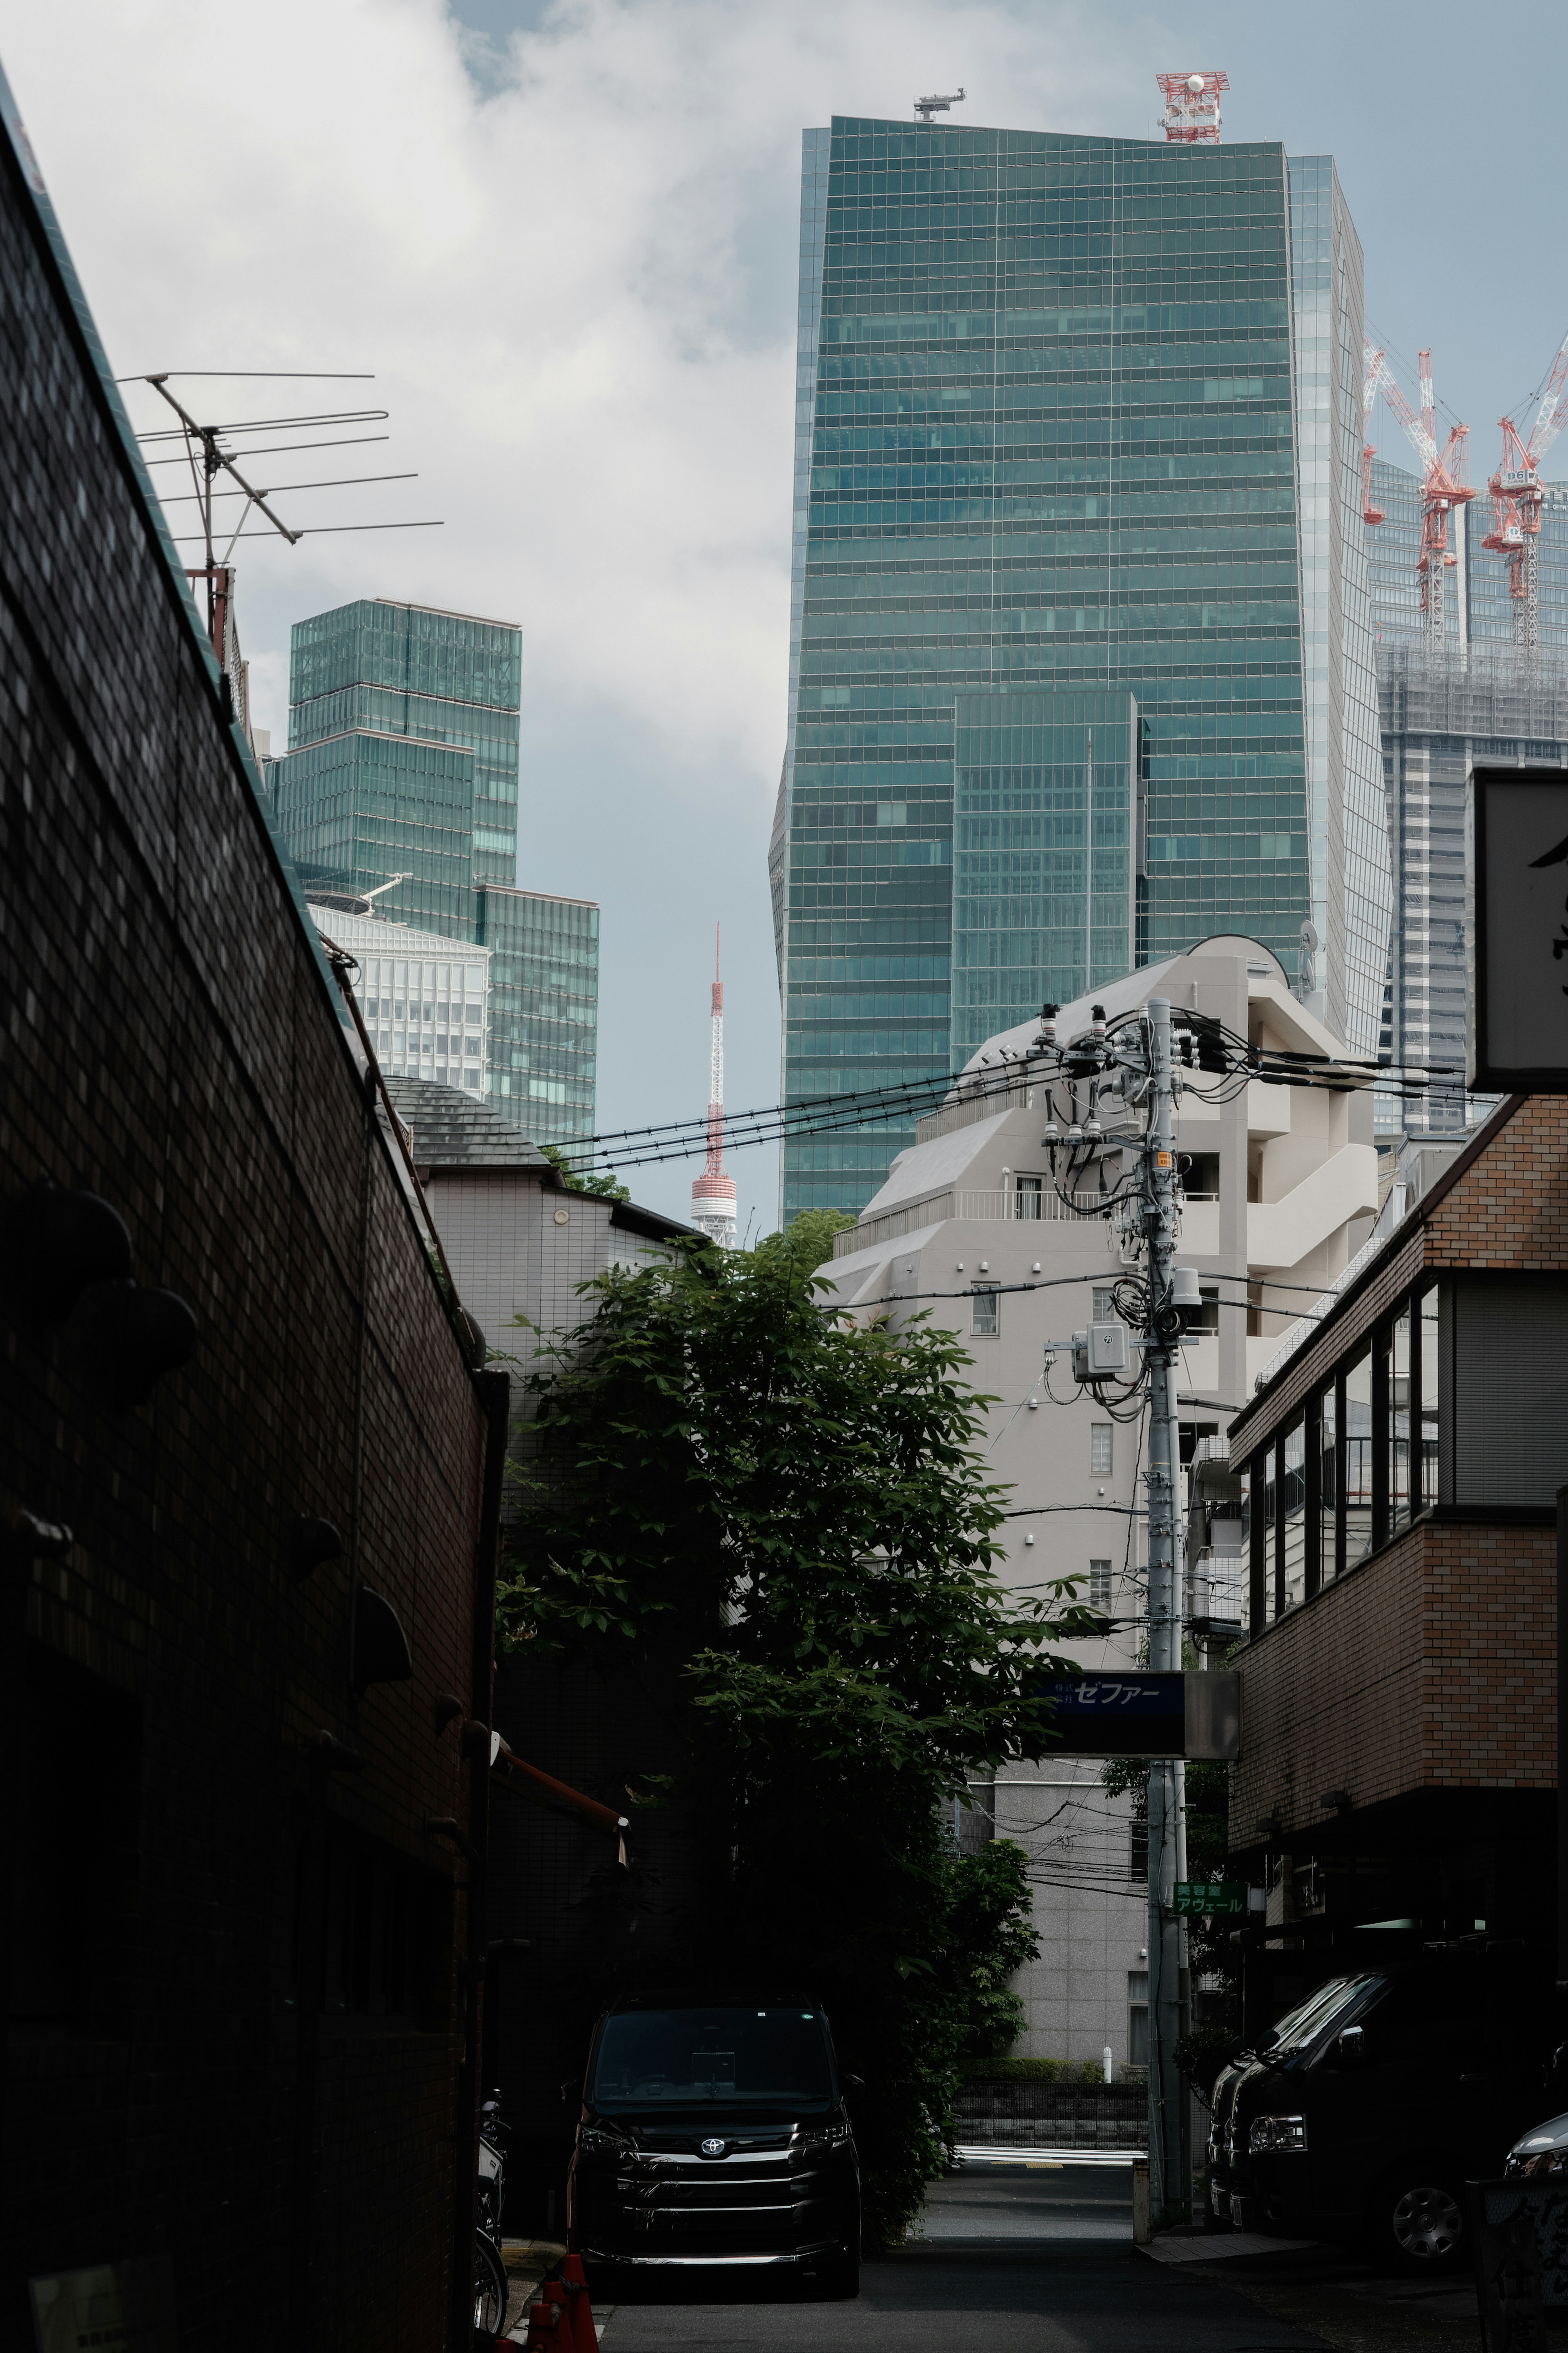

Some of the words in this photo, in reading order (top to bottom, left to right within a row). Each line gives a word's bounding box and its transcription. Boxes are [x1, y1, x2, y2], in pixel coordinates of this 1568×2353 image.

[1055, 1683, 1074, 1693] 株式
[1075, 1681, 1160, 1705] ゼファー
[1178, 1885, 1221, 1896] 美容室
[1178, 1898, 1243, 1913] アヴェール
